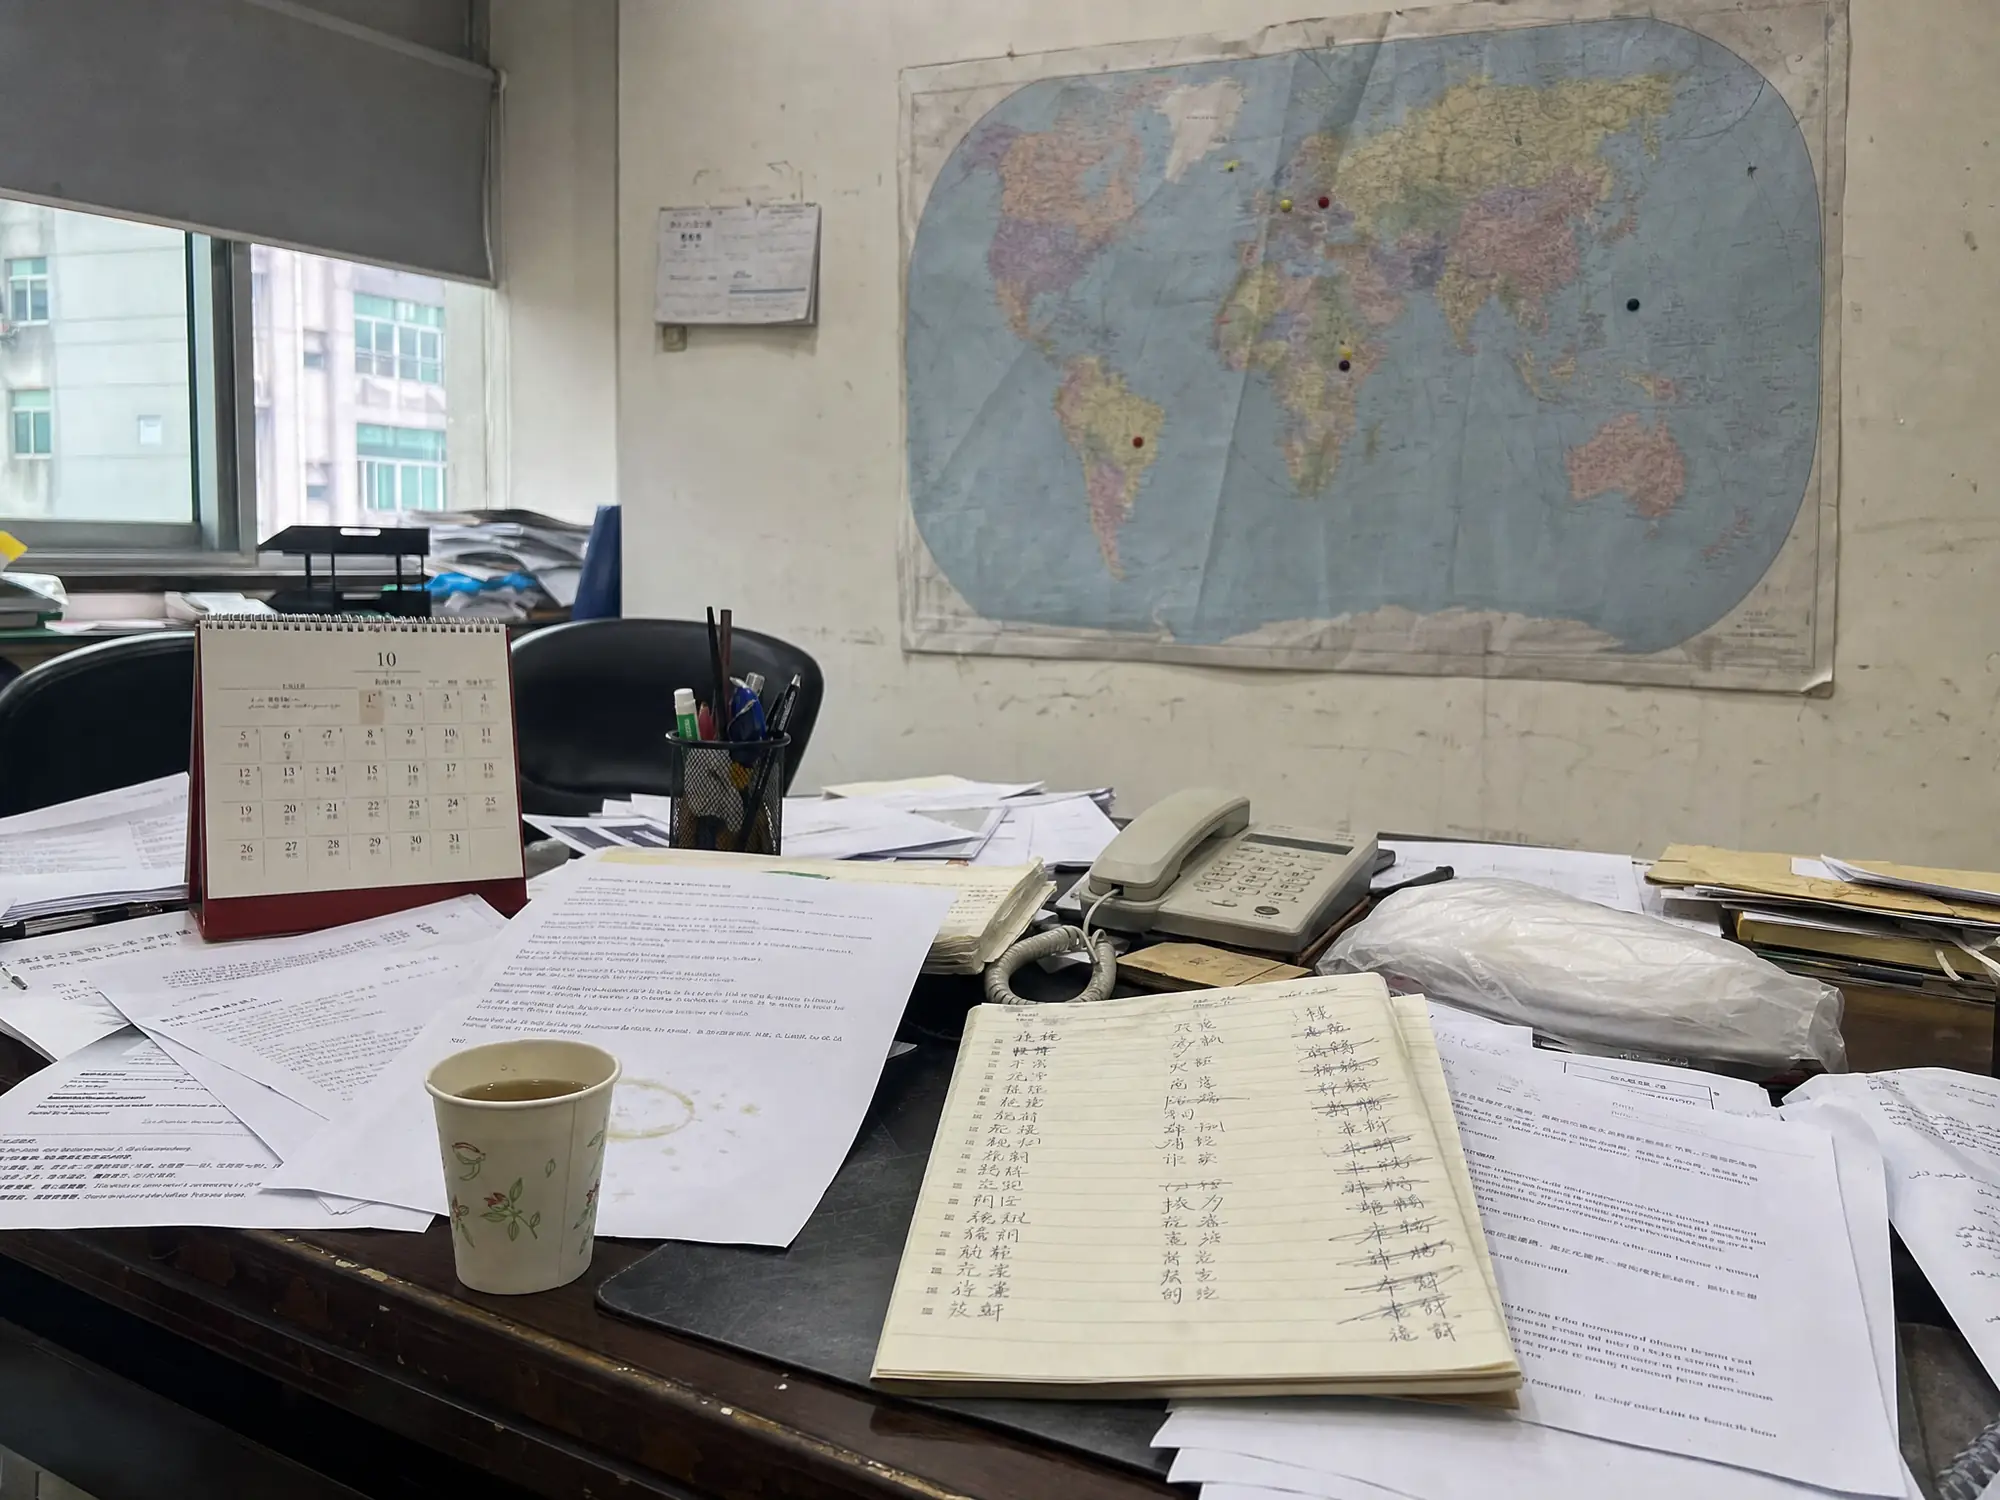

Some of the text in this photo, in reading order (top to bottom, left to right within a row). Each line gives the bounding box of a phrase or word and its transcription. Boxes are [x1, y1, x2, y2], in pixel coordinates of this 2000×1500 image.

[376, 652, 397, 667] 10
[444, 728, 456, 737] 10
[481, 727, 491, 737] 11
[239, 762, 494, 778] 12 13 14 15 16 17 18
[240, 796, 496, 815] 19 20 21 22 23 24 25
[240, 833, 459, 854] 26 27 28 29 30 31
